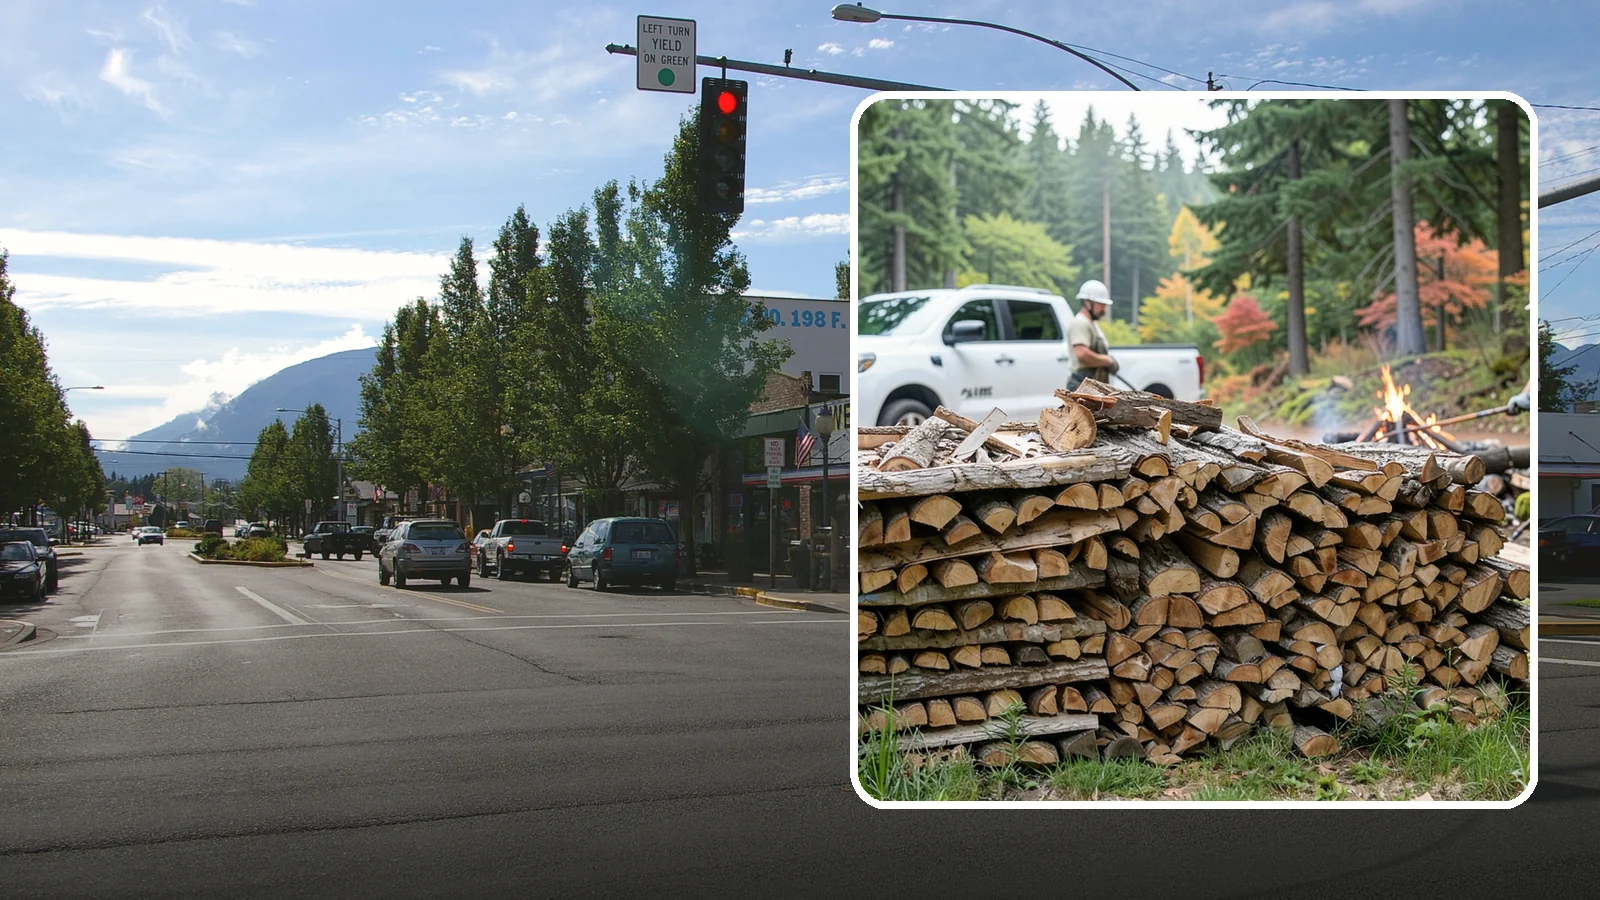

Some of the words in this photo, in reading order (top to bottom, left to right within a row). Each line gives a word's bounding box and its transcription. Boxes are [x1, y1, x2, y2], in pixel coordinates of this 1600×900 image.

[642, 23, 663, 34] LEFT
[668, 25, 690, 37] TURN
[652, 37, 682, 52] YIELD
[643, 53, 656, 63] ON
[661, 54, 690, 66] GREEN
[791, 309, 826, 328] 198
[831, 311, 847, 329] F.
